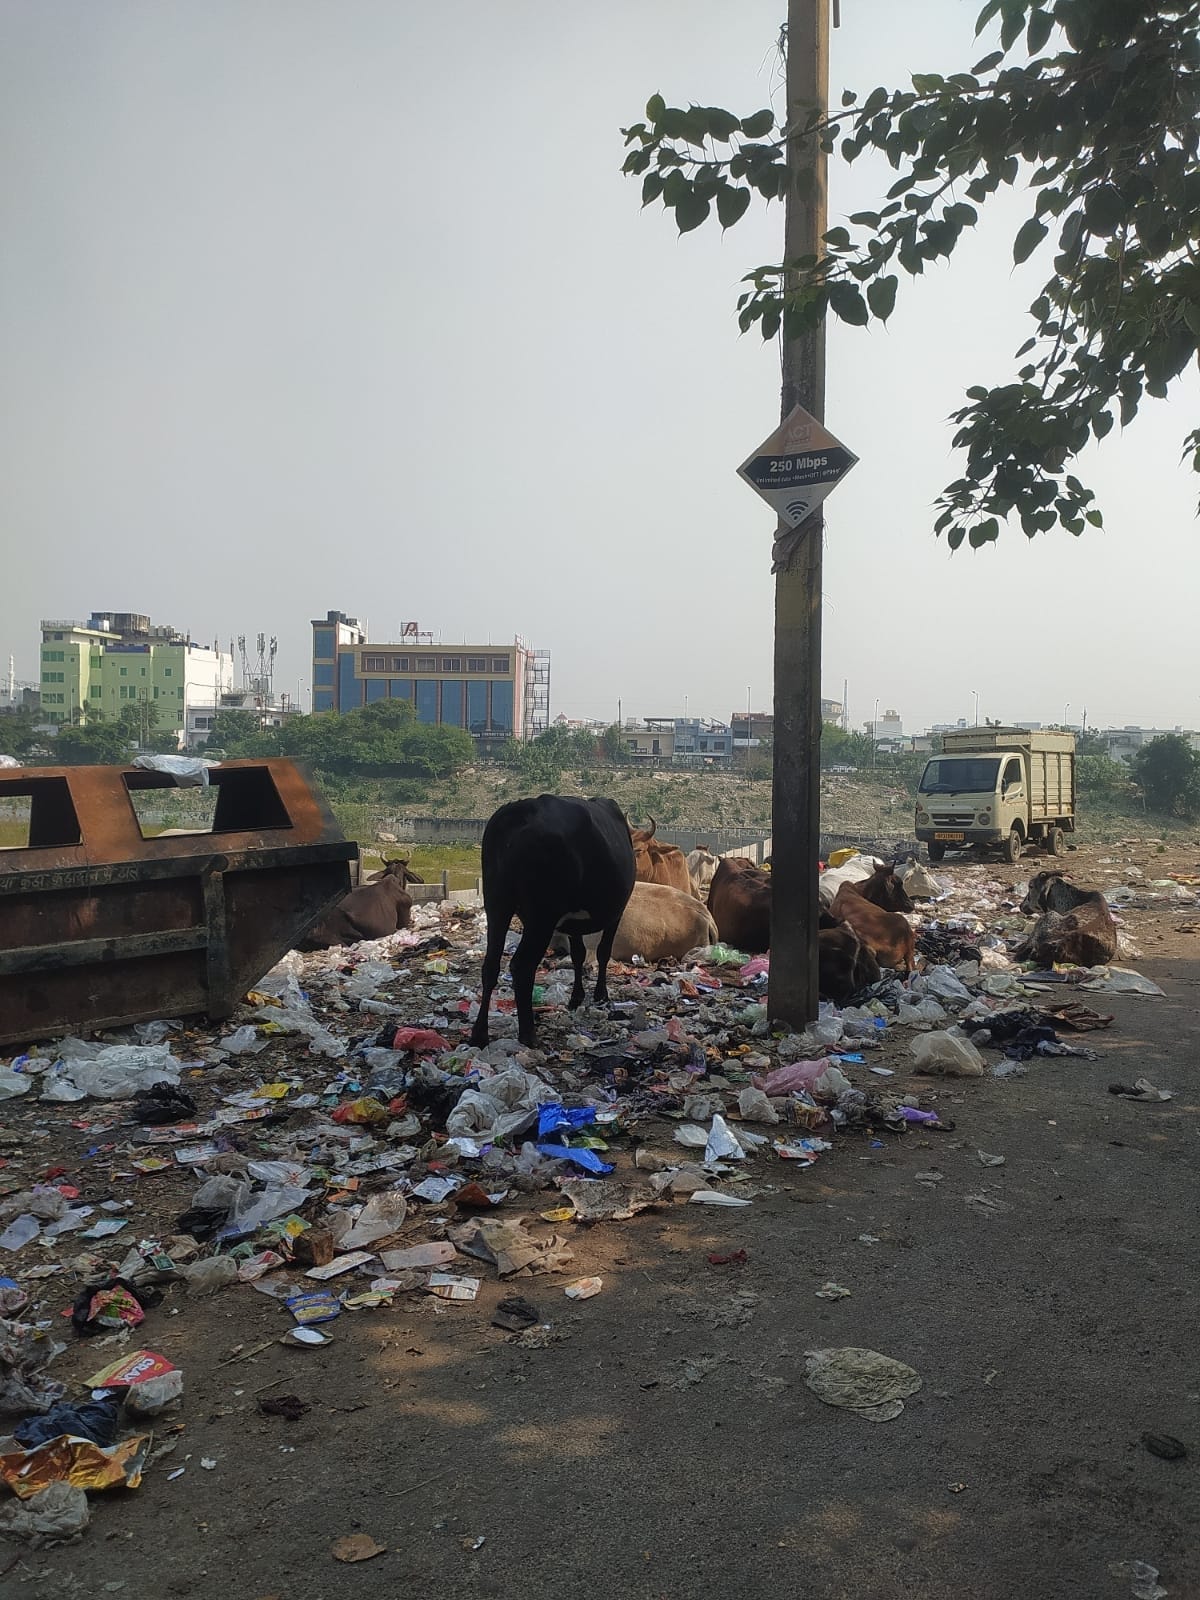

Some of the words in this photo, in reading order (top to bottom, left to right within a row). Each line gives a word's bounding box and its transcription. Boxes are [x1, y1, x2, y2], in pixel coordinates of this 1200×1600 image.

[769, 460, 793, 473] 250
[796, 457, 828, 470] Mbps
[121, 1358, 155, 1382] CRAX
